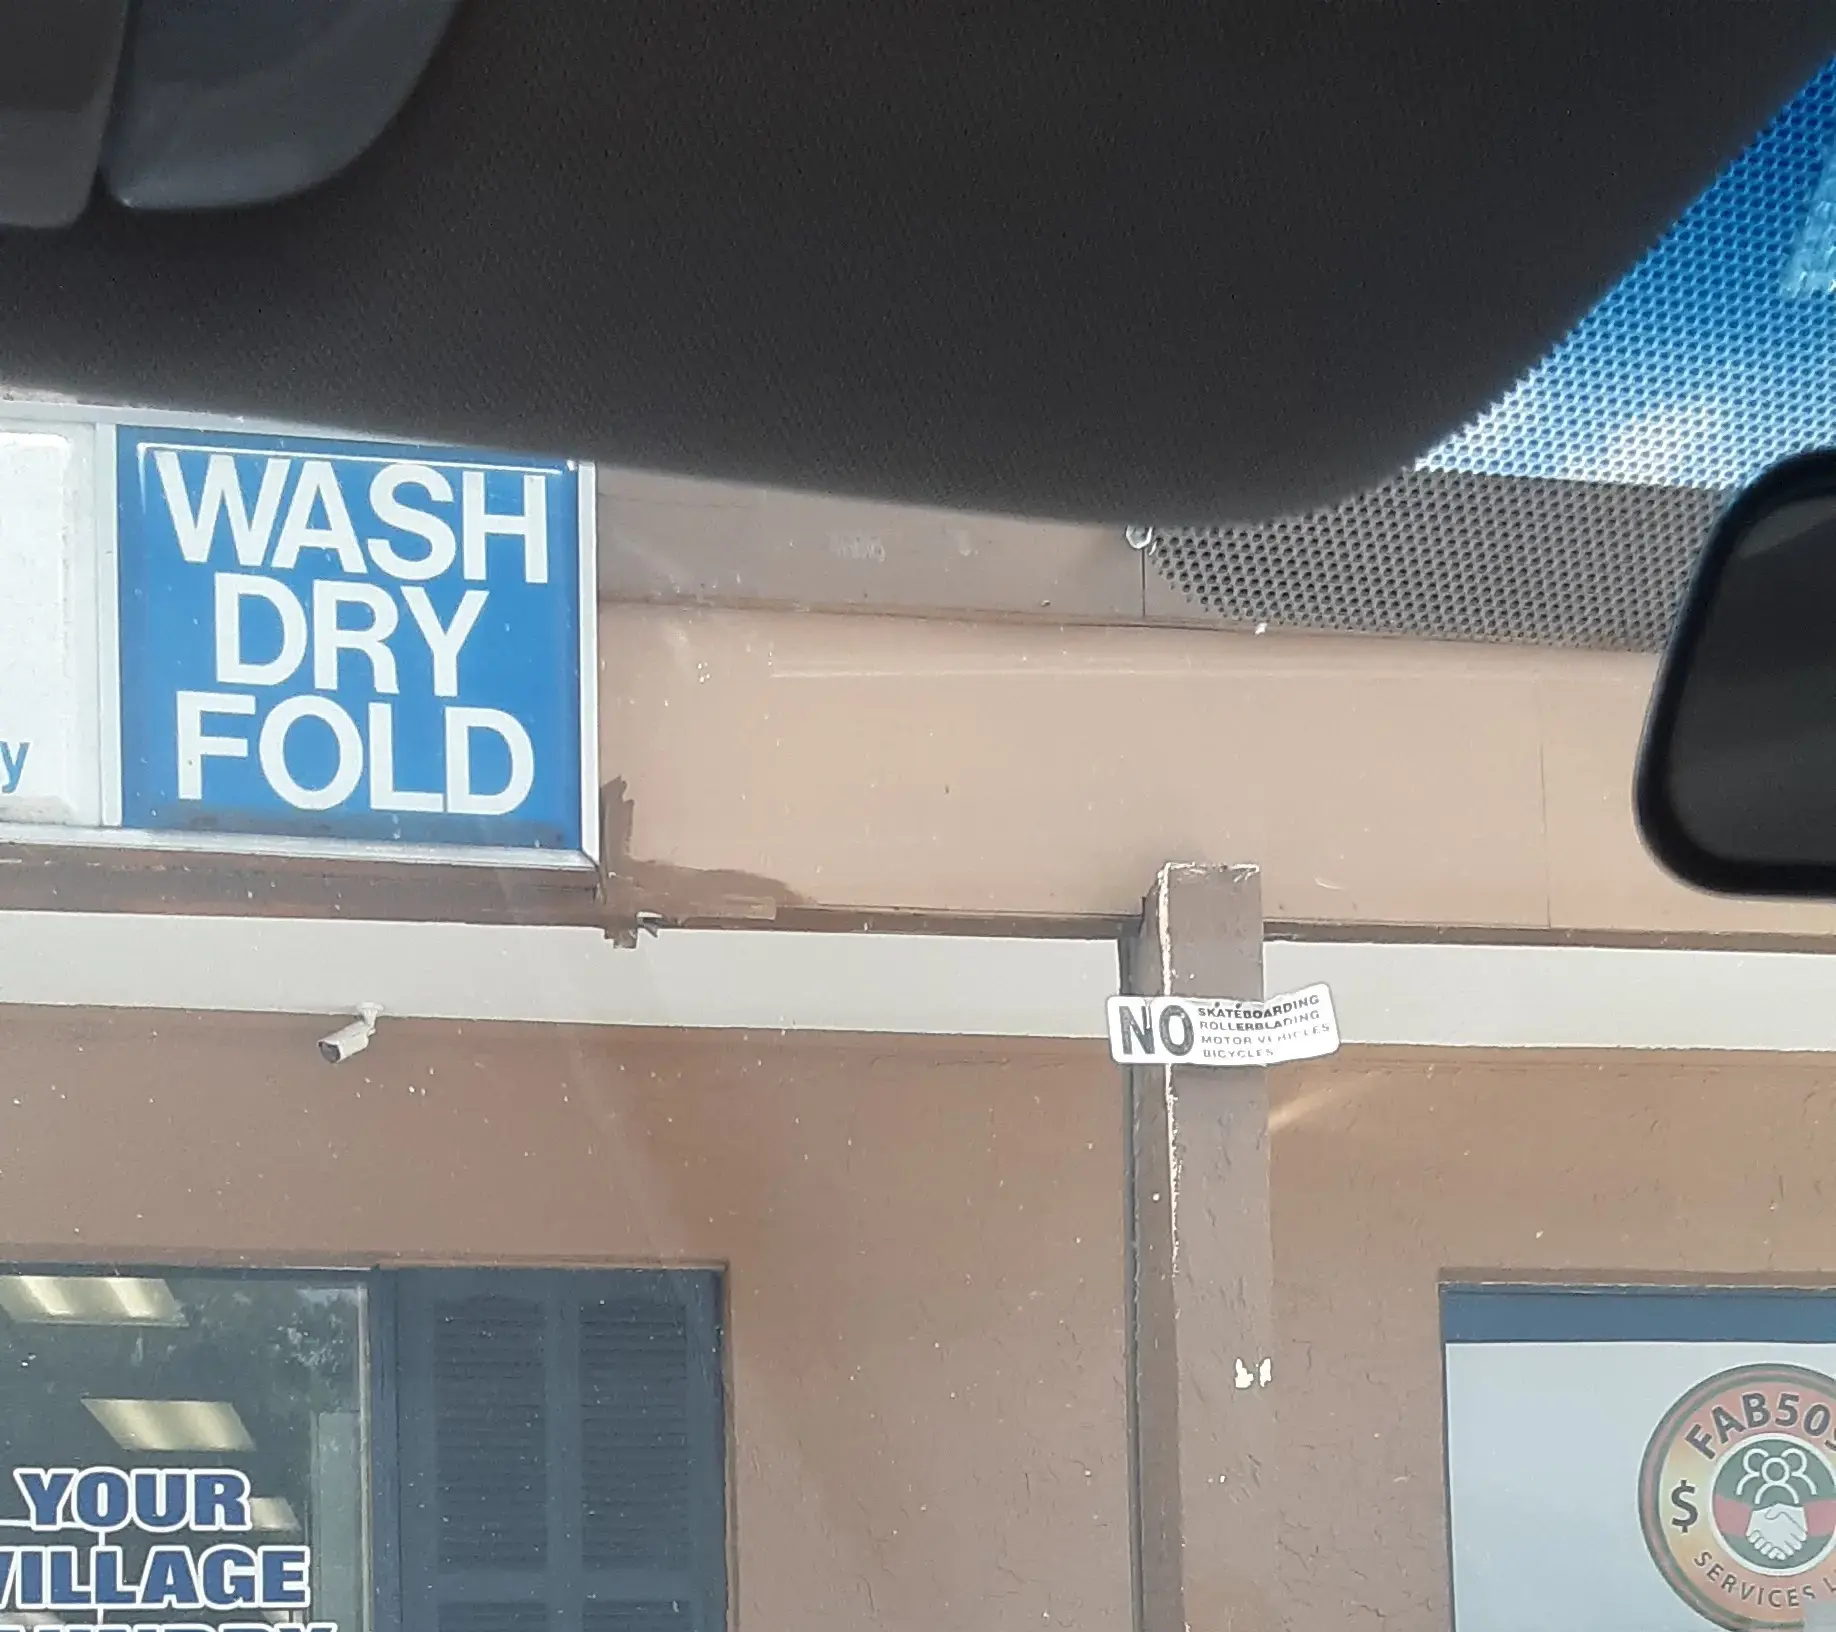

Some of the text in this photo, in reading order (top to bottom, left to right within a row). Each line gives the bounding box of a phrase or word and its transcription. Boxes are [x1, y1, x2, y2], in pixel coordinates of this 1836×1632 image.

[153, 449, 549, 584] WASH
[214, 572, 490, 697] DRY
[176, 690, 536, 816] FOLD
[1118, 1004, 1195, 1057] NO
[1198, 994, 1320, 1019] SKATEBOARDING
[1199, 1009, 1321, 1032] ROLLERBLADING
[1201, 1035, 1252, 1045] MOTOR
[1203, 1047, 1274, 1059] BICYCLES
[12, 1466, 253, 1533] YOUR
[1693, 1551, 1817, 1608] SERVICES
